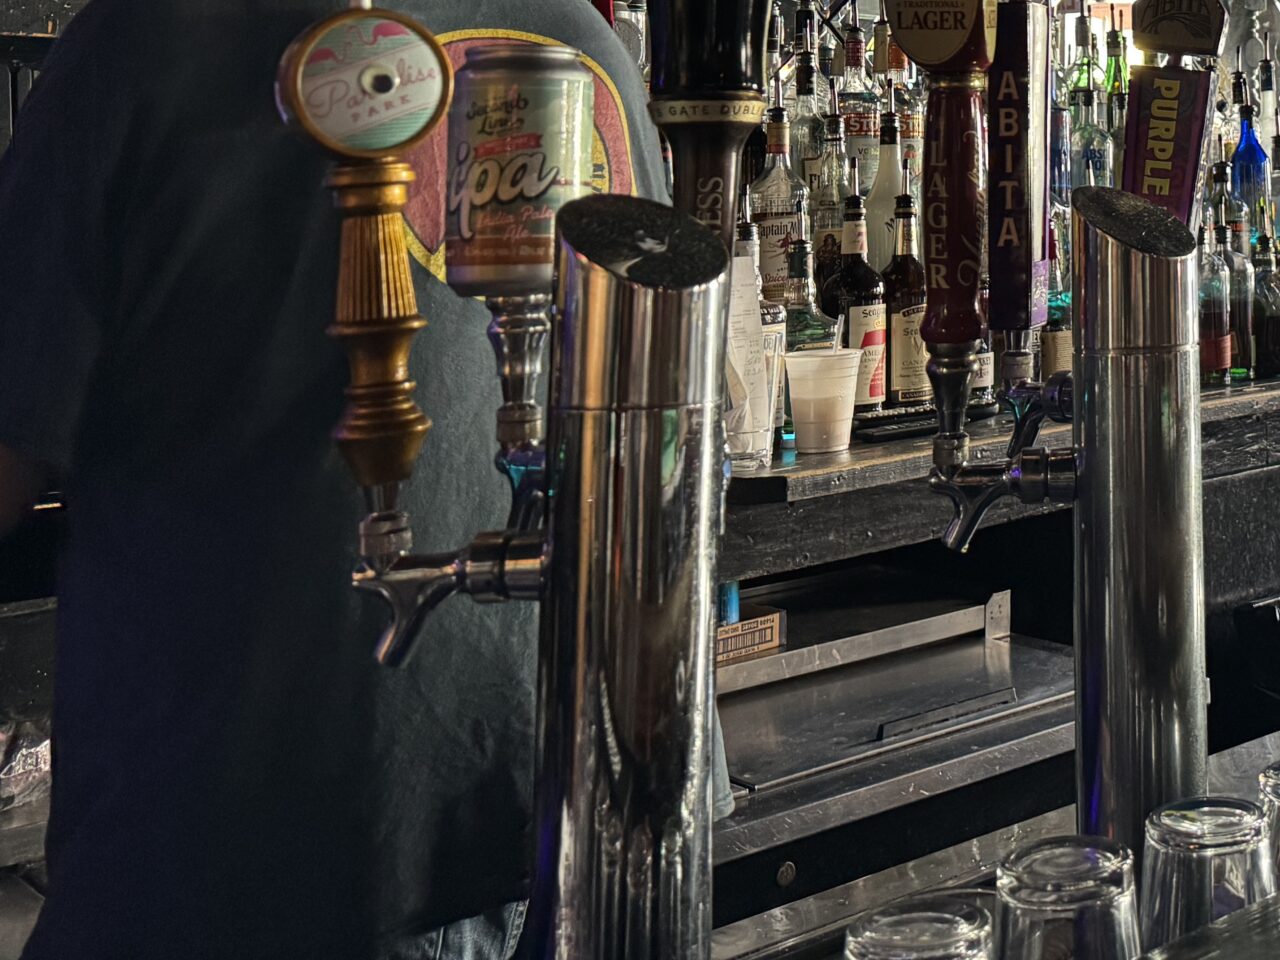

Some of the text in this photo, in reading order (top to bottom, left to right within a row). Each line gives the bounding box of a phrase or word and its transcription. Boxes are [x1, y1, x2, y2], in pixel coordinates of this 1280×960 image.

[903, 0, 961, 9] TRADITIONAL
[896, 10, 967, 31] LAGER
[668, 105, 710, 116] GATE
[720, 104, 764, 116] DUBLI
[1142, 77, 1181, 197] PURPLE
[996, 70, 1021, 248] ABITA
[926, 140, 950, 289] LAGER
[759, 221, 788, 239] aptain
